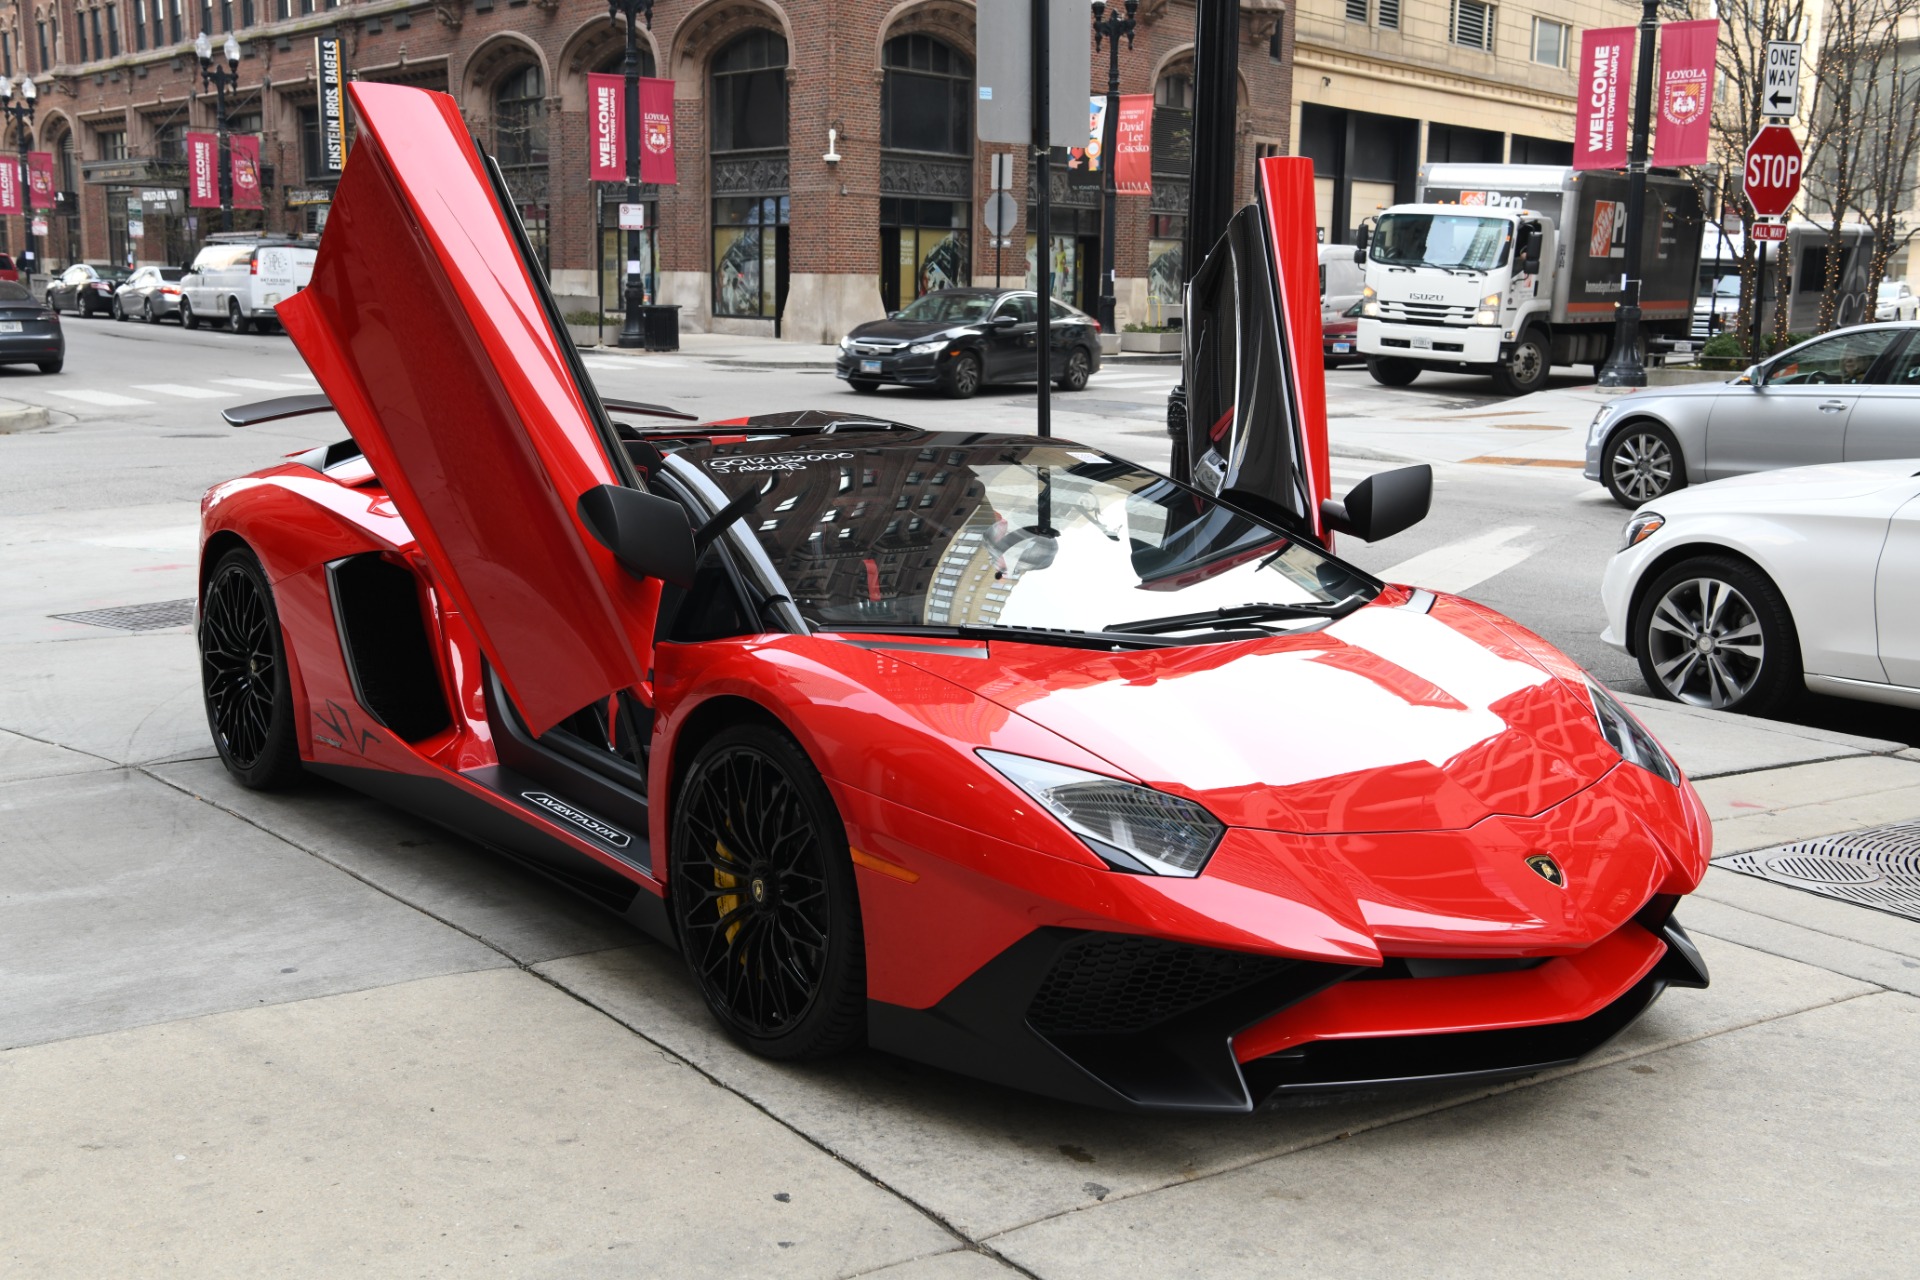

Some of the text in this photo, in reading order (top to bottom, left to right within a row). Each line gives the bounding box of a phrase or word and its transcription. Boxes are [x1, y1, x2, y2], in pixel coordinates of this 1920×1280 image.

[1770, 49, 1797, 66] ONE
[1666, 69, 1707, 80] LOYOLA
[1768, 69, 1796, 86] WAY
[323, 40, 342, 170] EINSTEIN BROS. BAGELS
[1589, 46, 1610, 152] WELCOME
[1605, 45, 1620, 152] WATER TOWER CAMPUS
[598, 87, 610, 167] WELCOME
[1120, 120, 1144, 132] David
[1128, 132, 1144, 142] Lee
[1118, 142, 1150, 153] Csicsko
[195, 142, 206, 198] WELCOME
[1748, 154, 1800, 188] STOP
[1115, 181, 1151, 192] LUMA
[1487, 191, 1522, 210] Pro
[1755, 228, 1783, 238] ALL WAY
[1409, 293, 1444, 301] ISUZU
[536, 797, 620, 840] AVENTADOR
